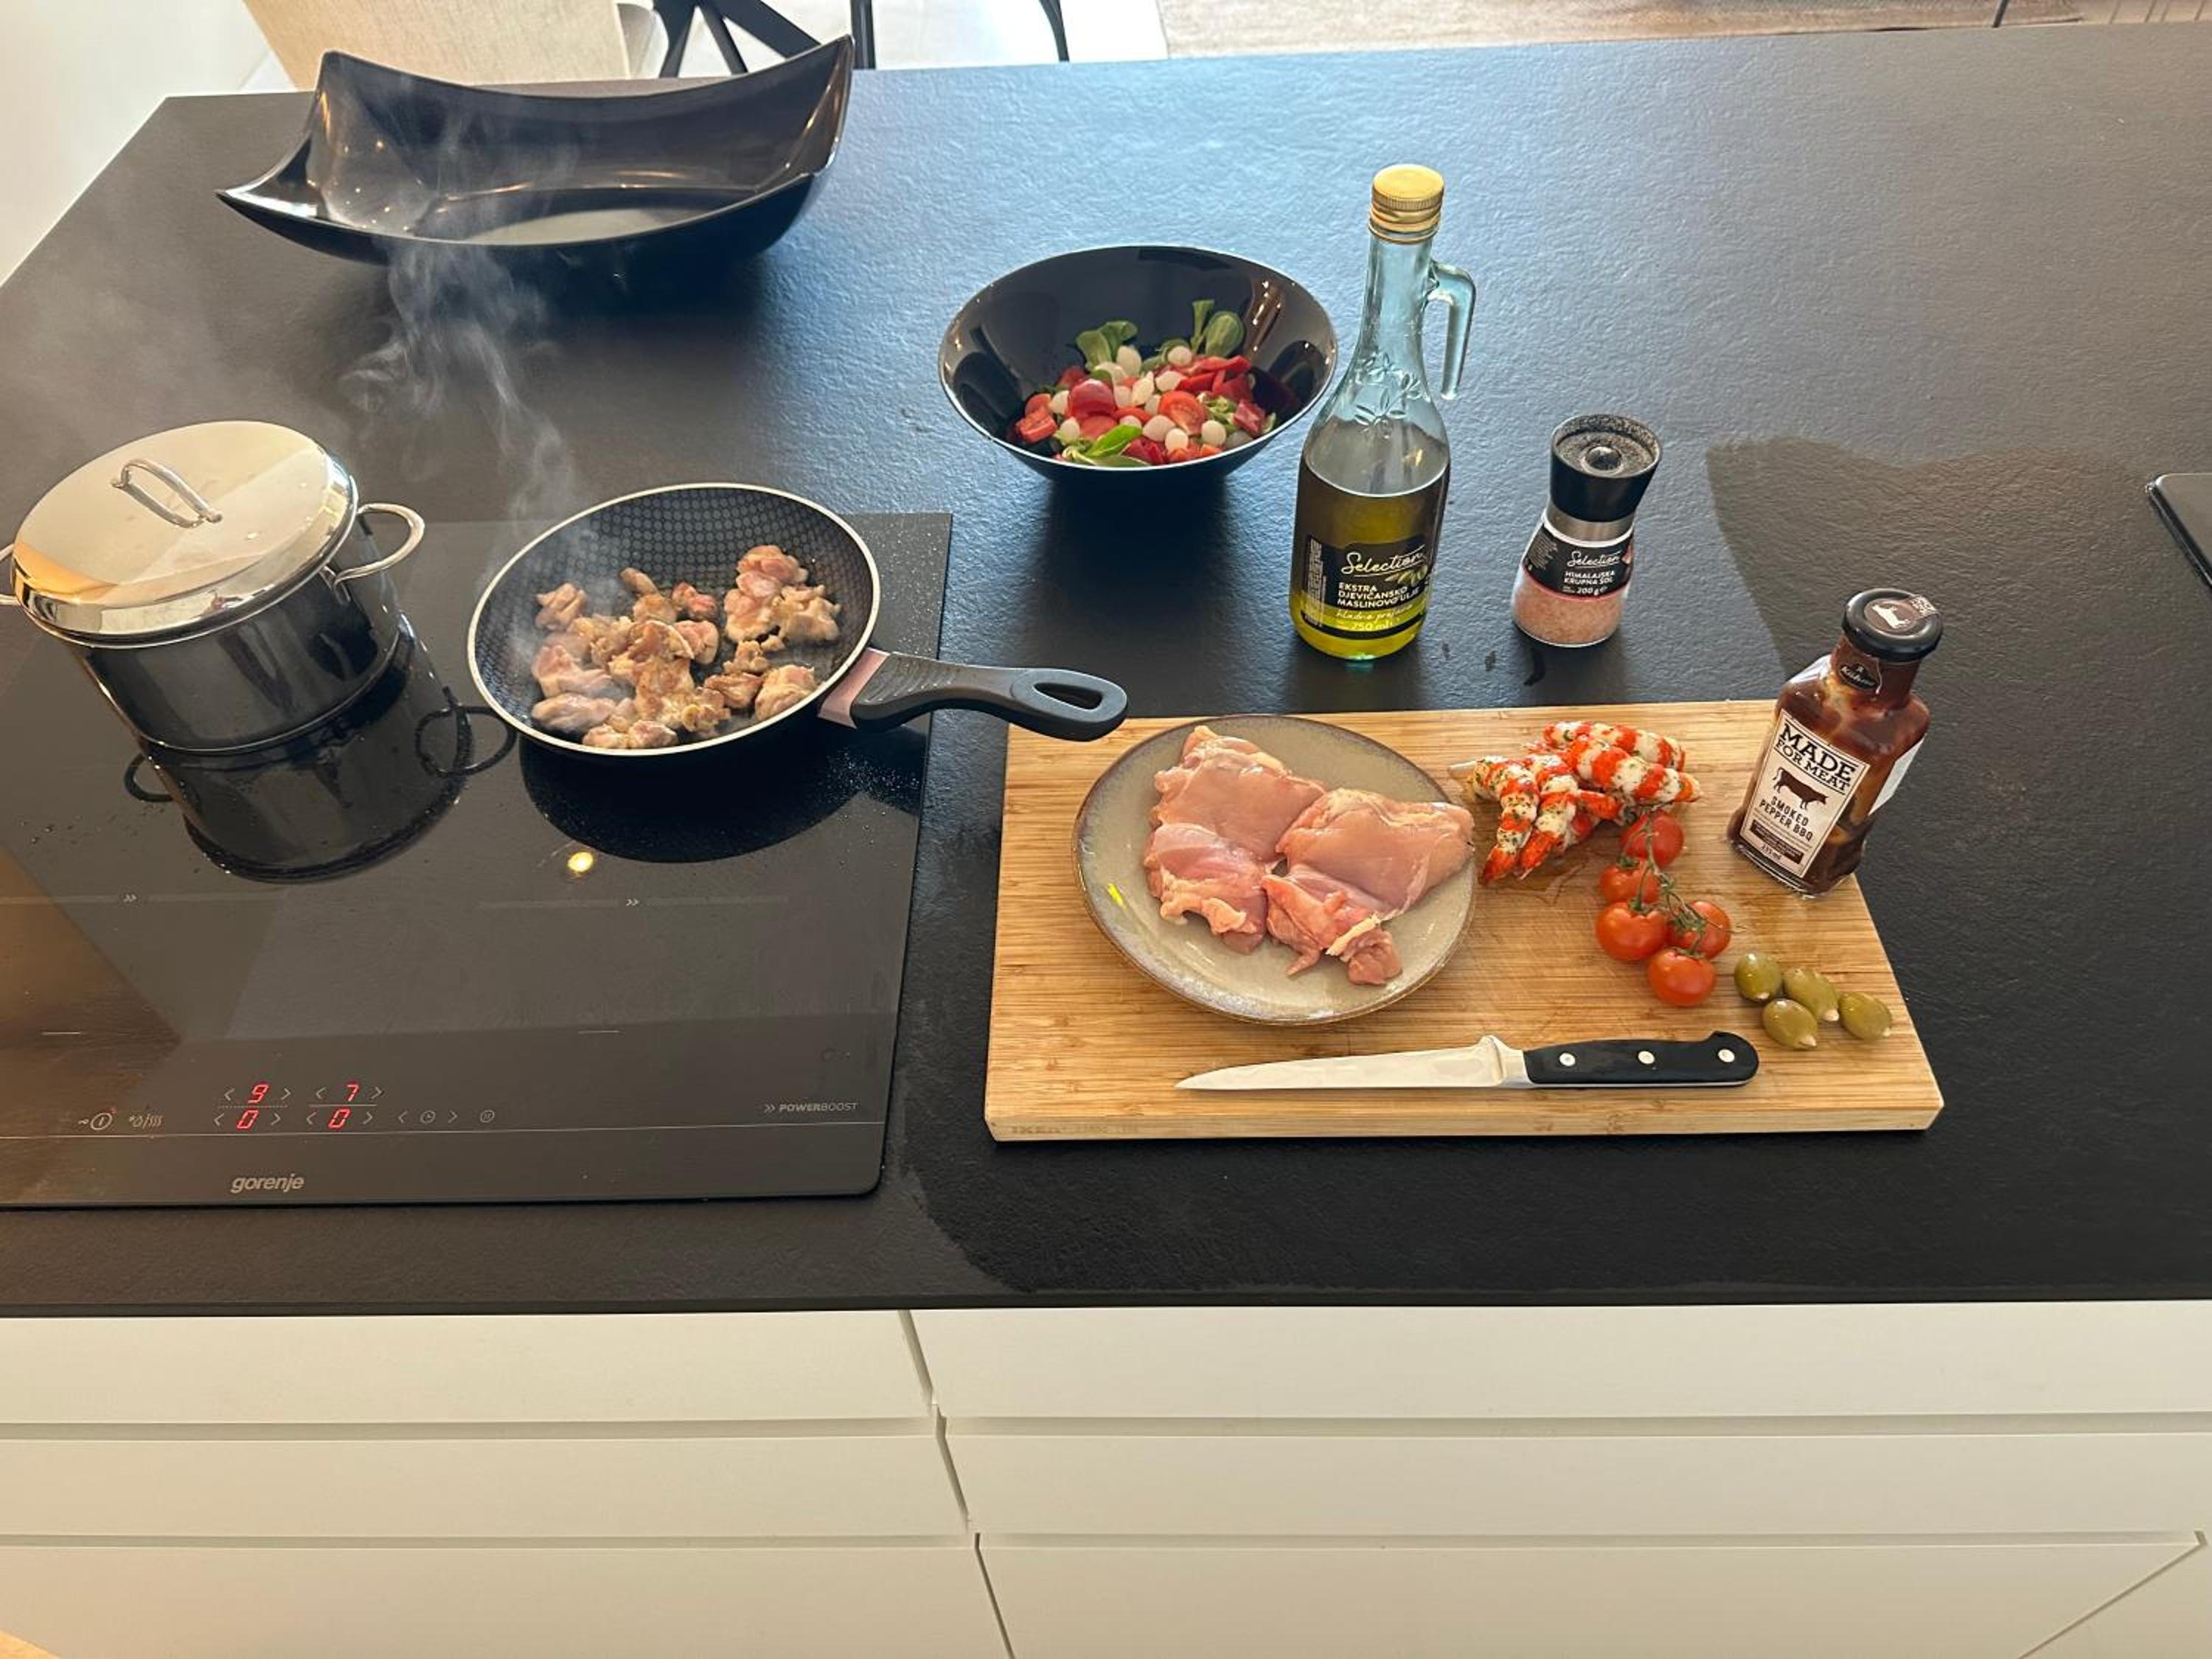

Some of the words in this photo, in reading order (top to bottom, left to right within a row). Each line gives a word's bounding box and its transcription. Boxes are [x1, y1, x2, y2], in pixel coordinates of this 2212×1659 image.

[1340, 544, 1427, 574] Selection
[1567, 550, 1621, 568] Selection
[1565, 570, 1615, 579] HIMALAJSKA
[1599, 577, 1613, 585] SOL
[1338, 582, 1378, 592] EKSTRA
[1338, 586, 1408, 599] DJEVIČANSKO
[1337, 597, 1397, 608] MASLINOVO
[1779, 723, 1856, 782] MADE
[1775, 739, 1803, 765] FOR
[1804, 762, 1851, 791] MEAT
[1759, 799, 1792, 829] PEPPER
[1792, 824, 1813, 841] BBQ
[1771, 796, 1809, 827] SMOKED
[247, 1083, 269, 1104] 9
[347, 1083, 360, 1102] 7
[779, 1102, 858, 1113] POWERBOOST
[236, 1109, 260, 1130] 0
[328, 1108, 351, 1129] 0
[230, 1173, 305, 1194] gorenje
